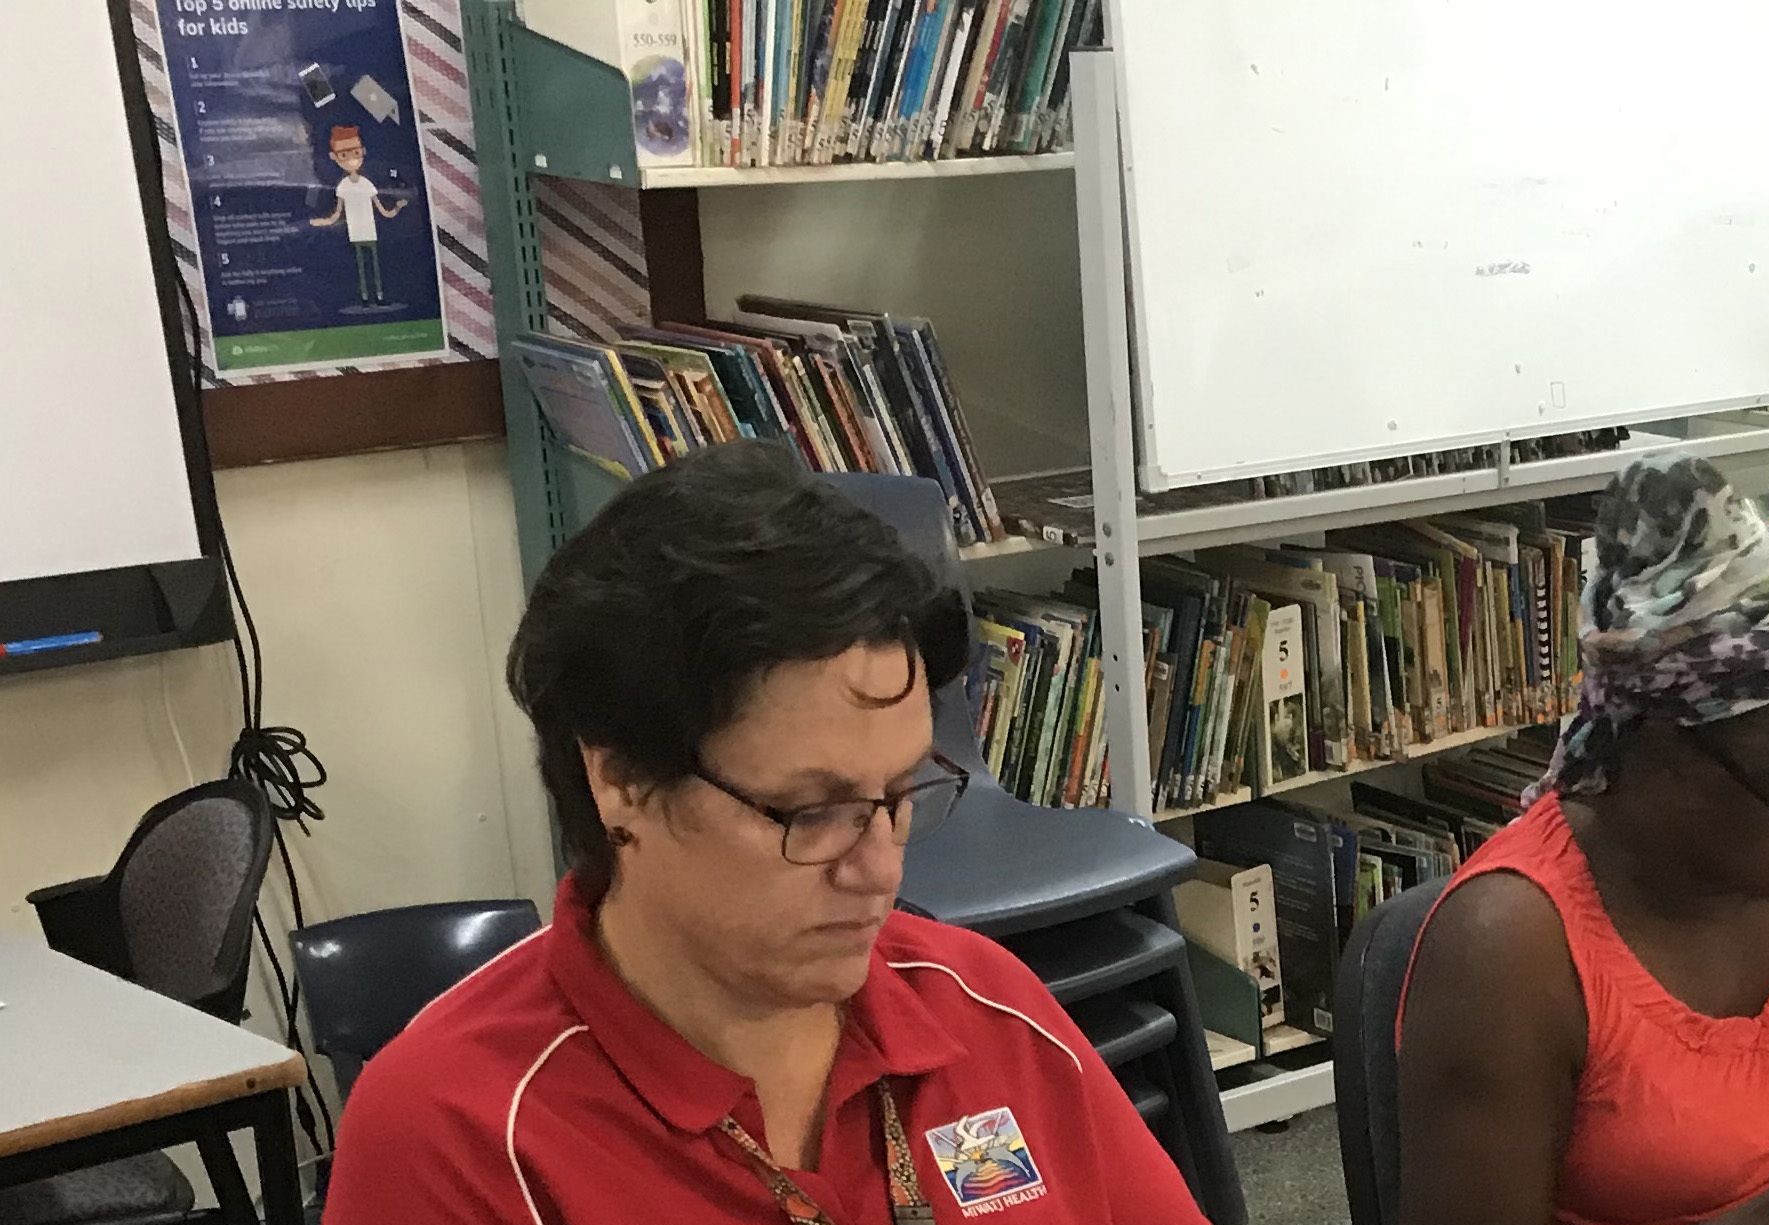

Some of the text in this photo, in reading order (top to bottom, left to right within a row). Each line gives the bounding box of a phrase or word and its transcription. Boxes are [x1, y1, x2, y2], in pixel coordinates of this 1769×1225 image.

[178, 17, 249, 37] for kids
[632, 33, 678, 48] 550-559
[190, 57, 199, 69] 1
[197, 100, 207, 114] 2
[206, 154, 216, 166] 3
[213, 195, 221, 208] 4
[221, 253, 230, 265] 5
[1278, 640, 1289, 662] 5
[1249, 890, 1260, 912] 5
[961, 1184, 1048, 1219] MIWATJ HEALTH
